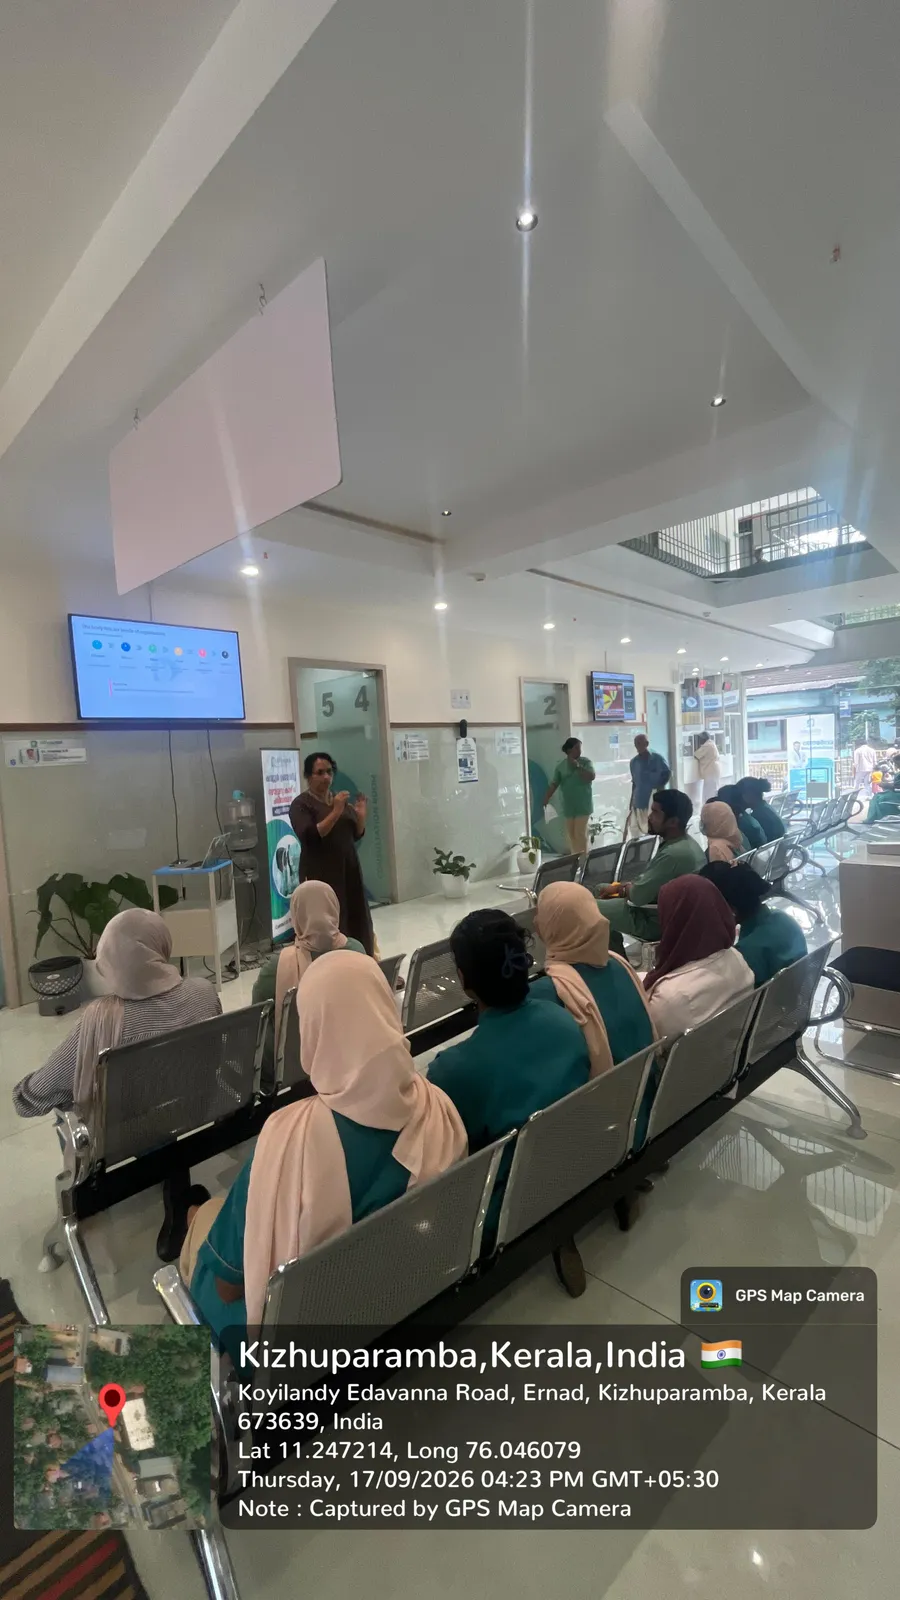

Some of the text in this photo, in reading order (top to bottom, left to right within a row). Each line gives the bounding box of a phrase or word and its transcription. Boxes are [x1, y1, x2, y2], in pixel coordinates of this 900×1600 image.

[321, 691, 335, 718] 5
[354, 685, 370, 712] 4
[543, 695, 557, 716] 2
[652, 699, 659, 715] 1
